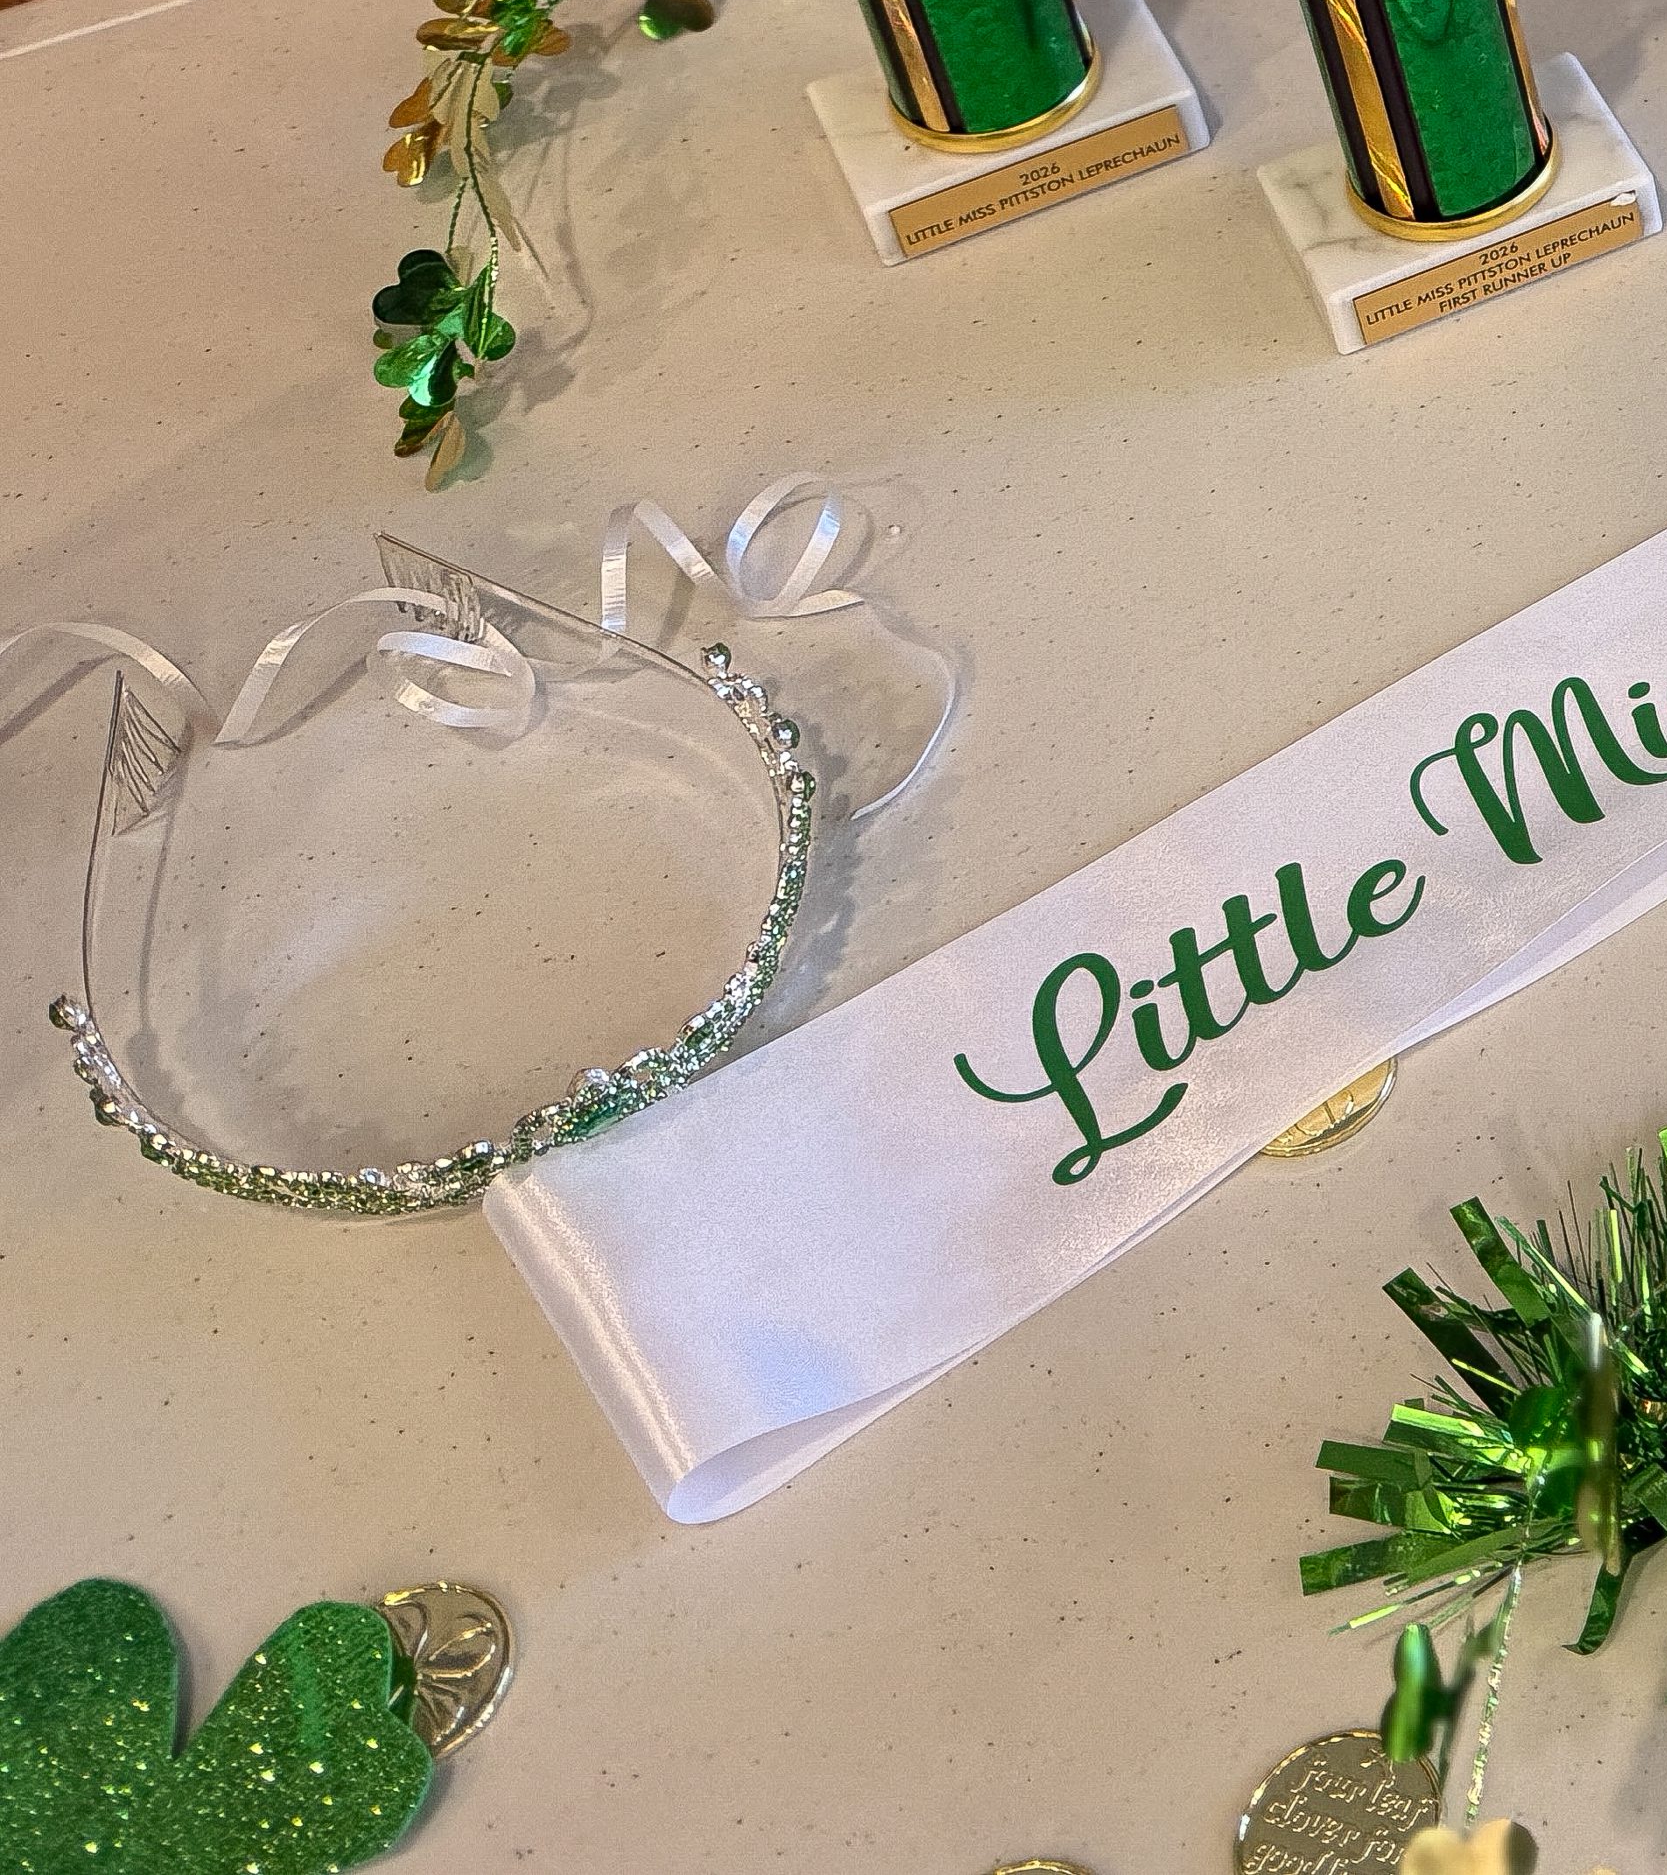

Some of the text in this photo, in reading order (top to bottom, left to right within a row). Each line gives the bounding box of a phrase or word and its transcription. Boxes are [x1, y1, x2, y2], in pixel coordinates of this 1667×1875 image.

[906, 133, 1181, 246] LITTLE MISS PITTSTON LEPRECHAUN
[1018, 162, 1061, 186] 2026
[1366, 211, 1635, 326] LITTLE MISS PITTSTON LEPRECHAUN
[1438, 252, 1573, 314] FIRST RUNNER UP
[1478, 241, 1519, 266] 2026
[954, 861, 1426, 1187] Little
[1263, 1793, 1360, 1847] clover
[1290, 1758, 1433, 1832] four leaf
